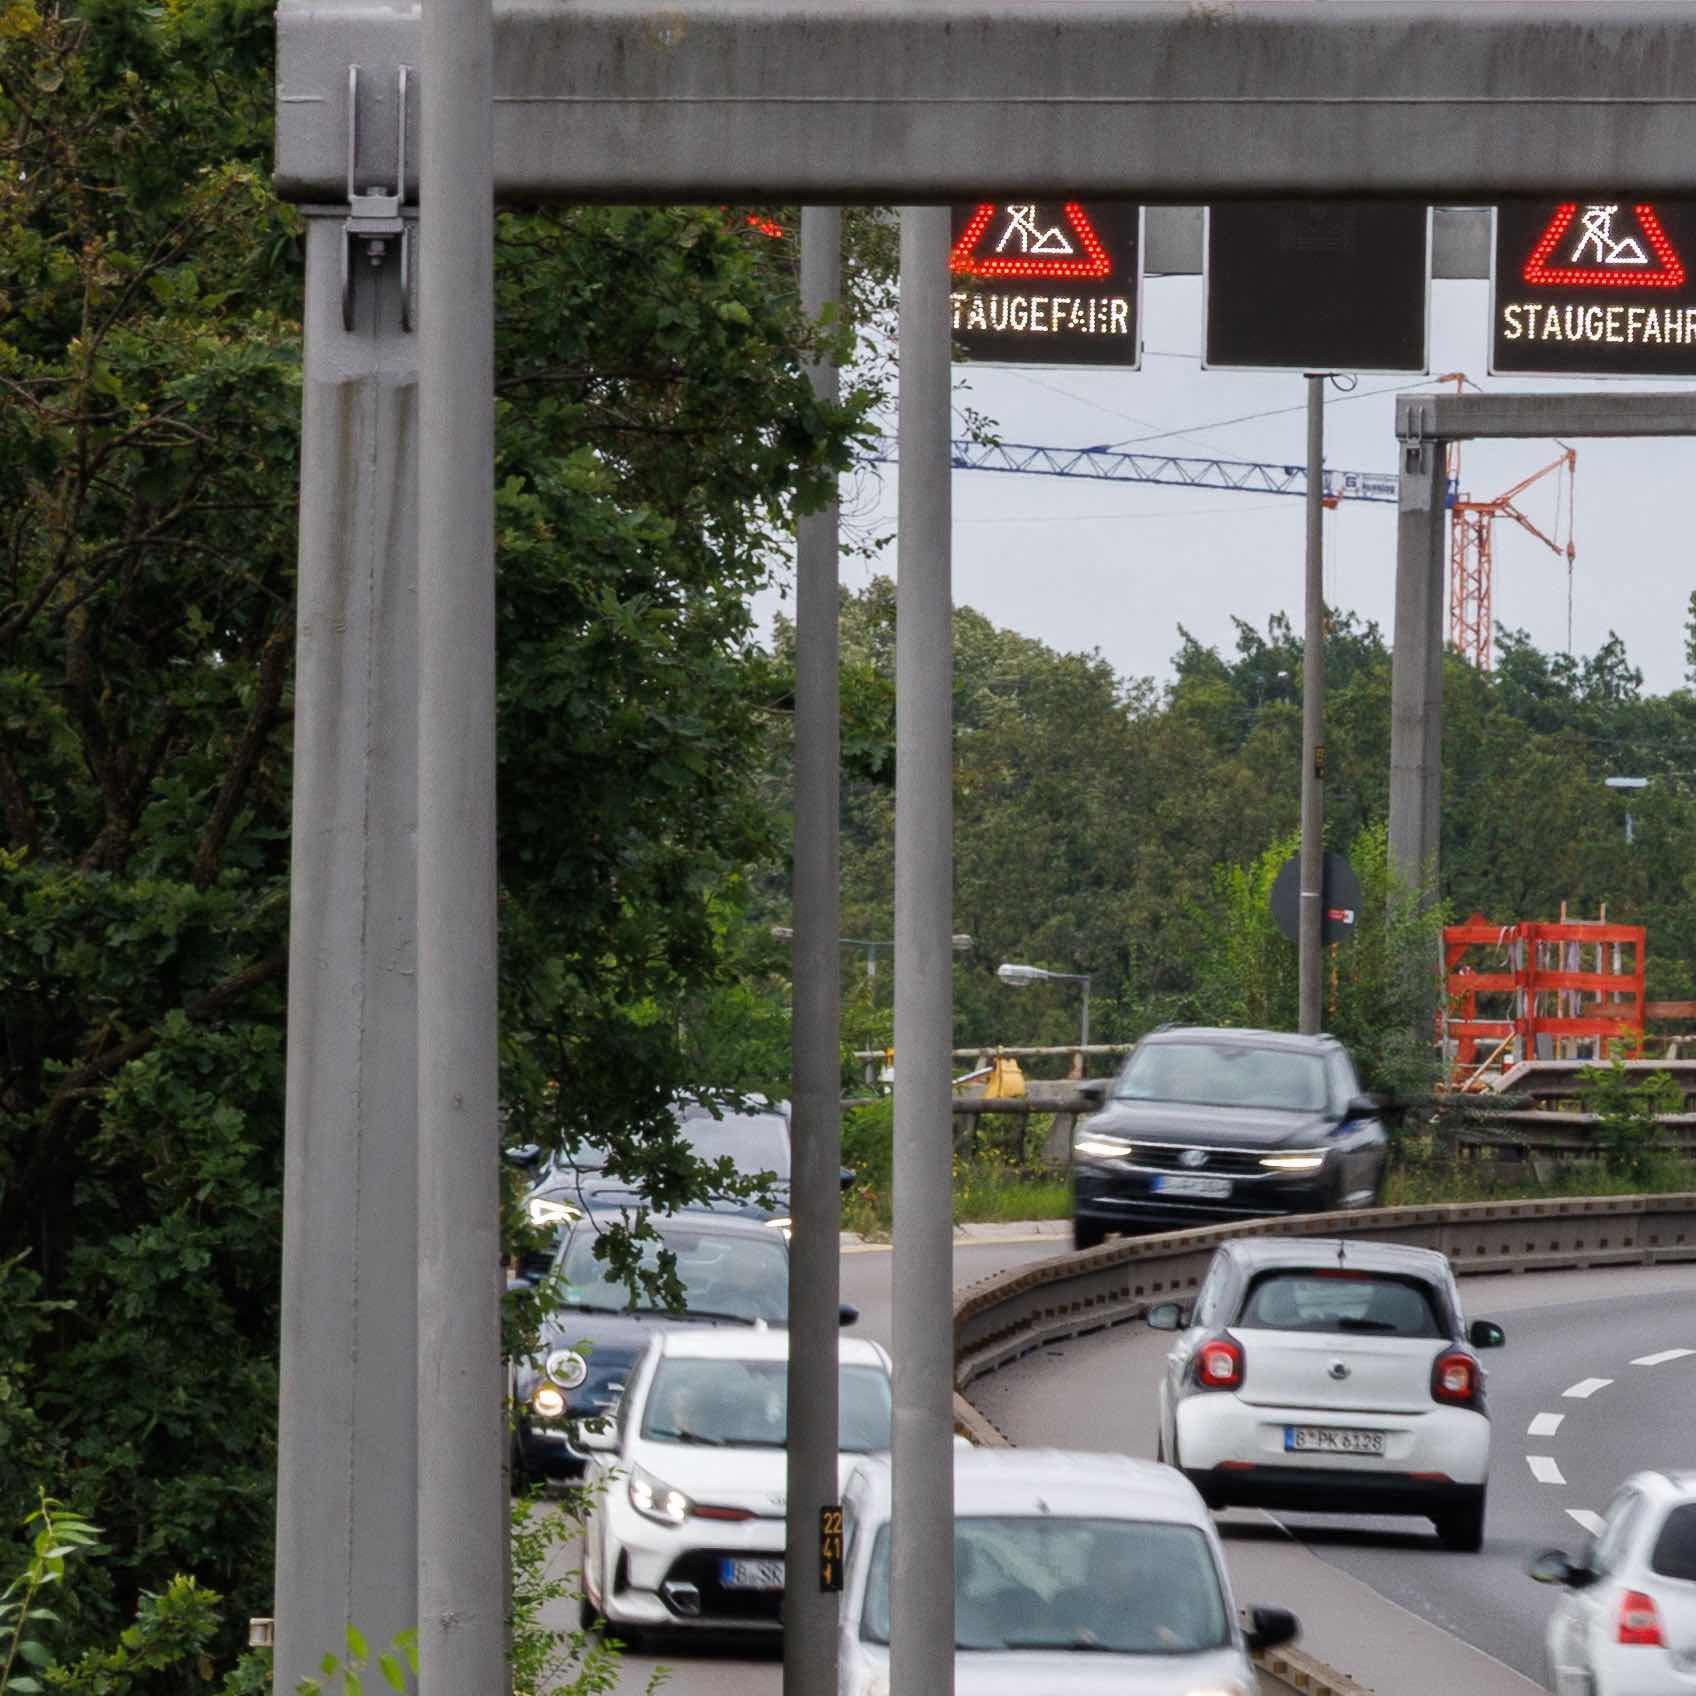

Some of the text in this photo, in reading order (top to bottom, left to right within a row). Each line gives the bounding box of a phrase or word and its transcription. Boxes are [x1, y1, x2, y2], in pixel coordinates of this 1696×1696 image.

[950, 291, 1129, 334] TAUGEFAHR
[823, 1512, 842, 1534] 22
[823, 1537, 841, 1559] 41
